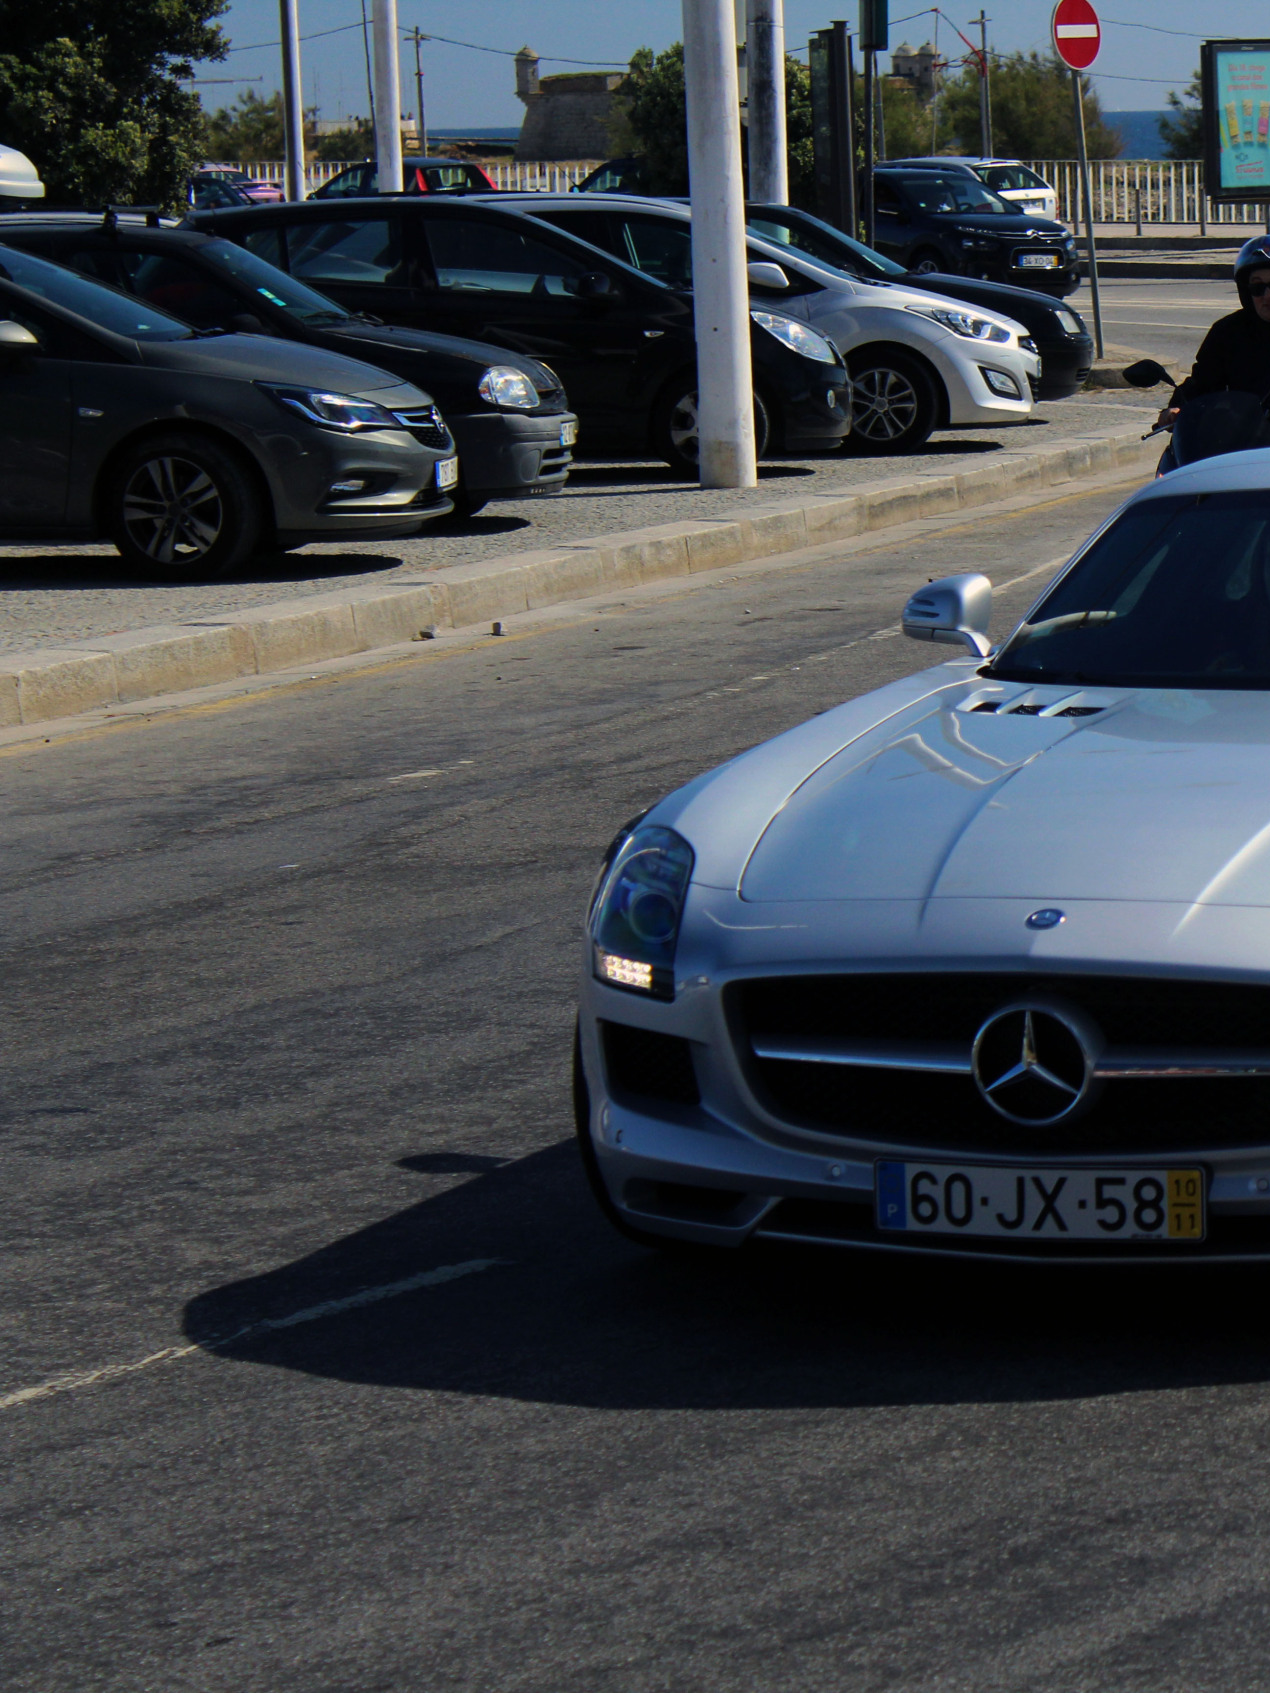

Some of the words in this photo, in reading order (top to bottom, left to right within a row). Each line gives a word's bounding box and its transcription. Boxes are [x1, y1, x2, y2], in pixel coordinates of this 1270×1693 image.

[1174, 1179, 1196, 1197] 10
[887, 1204, 898, 1217] P
[1175, 1213, 1195, 1231] 11
